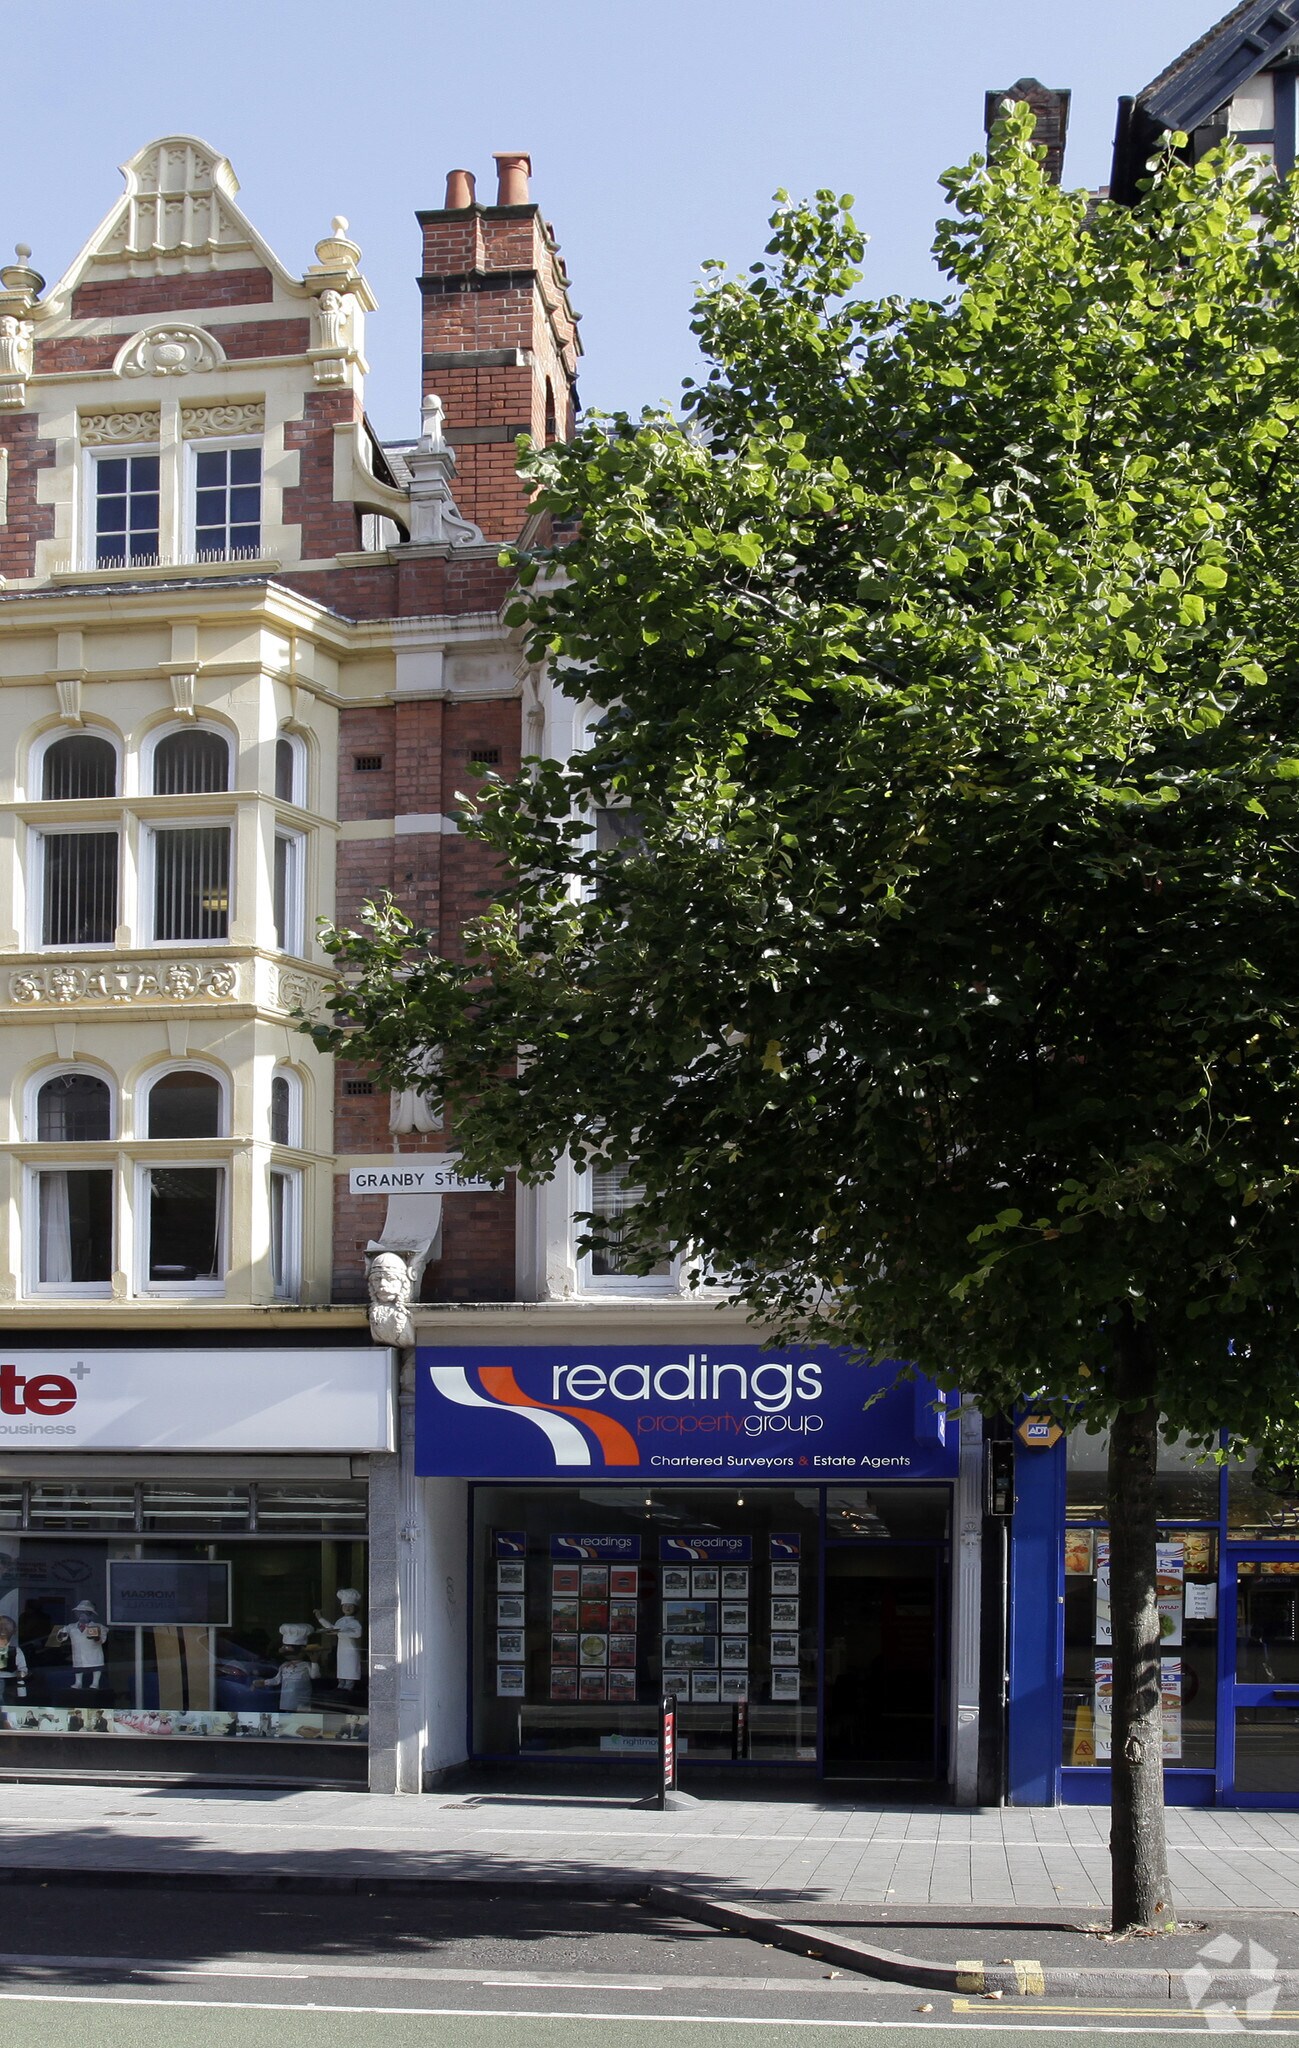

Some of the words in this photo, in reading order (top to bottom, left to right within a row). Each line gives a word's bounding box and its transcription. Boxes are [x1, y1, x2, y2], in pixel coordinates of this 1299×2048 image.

[356, 1173, 425, 1187] GRANBY
[435, 1172, 488, 1187] STREE
[553, 1353, 823, 1412] readings
[1028, 1426, 1048, 1435] ADT
[650, 1455, 723, 1466] Chartered
[726, 1455, 794, 1468] Surveyors
[798, 1456, 808, 1466] &
[813, 1455, 857, 1466] Estate
[860, 1455, 911, 1469] Agents
[580, 1536, 632, 1547] readings
[690, 1537, 743, 1548] readings
